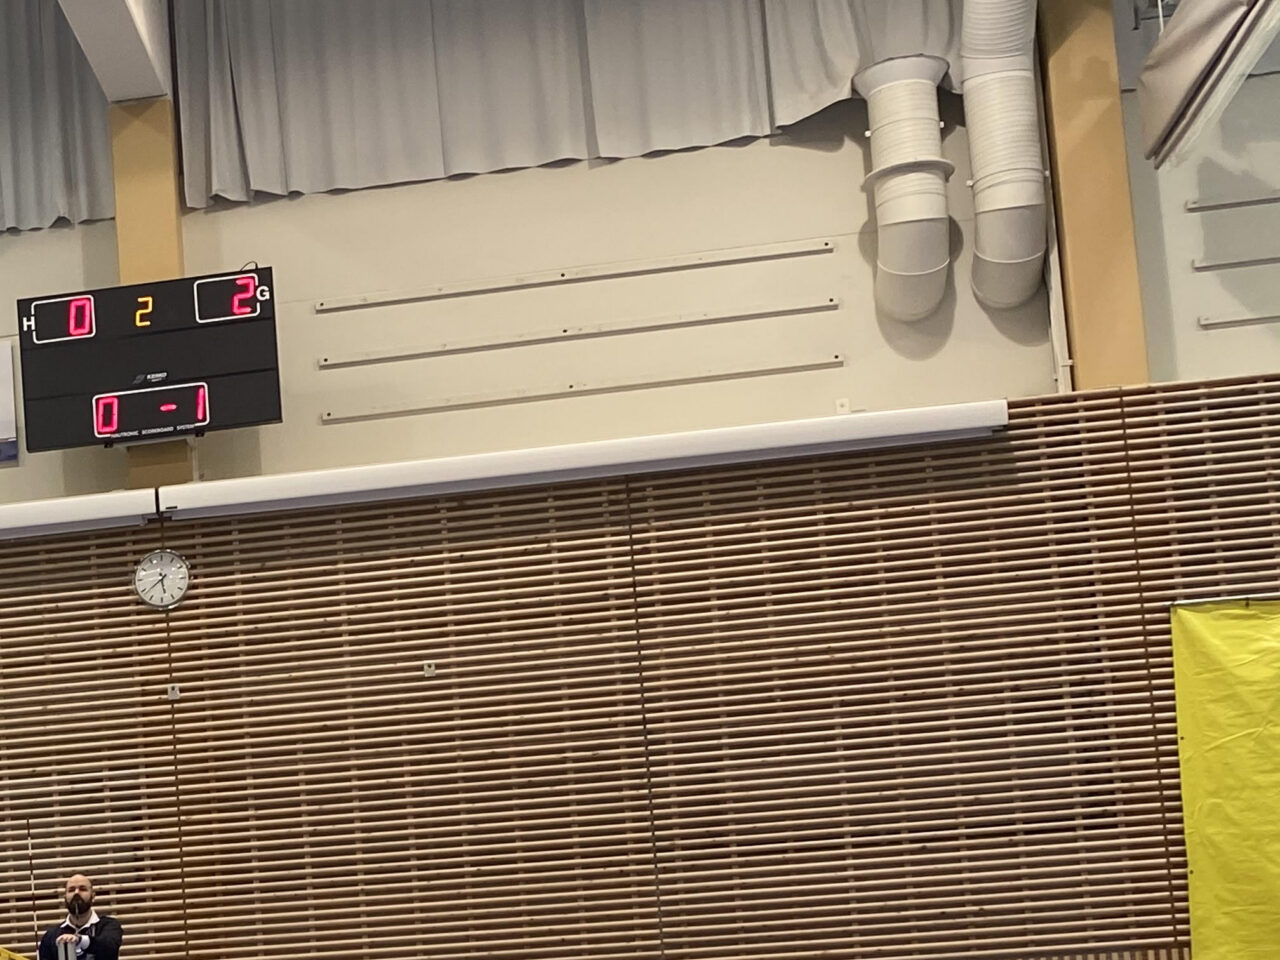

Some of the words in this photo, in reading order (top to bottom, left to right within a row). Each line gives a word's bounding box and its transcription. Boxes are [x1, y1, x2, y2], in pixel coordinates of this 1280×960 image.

[231, 277, 255, 314] 2
[256, 286, 270, 300] G
[22, 316, 35, 331] H
[70, 298, 91, 335] 0
[136, 297, 153, 326] 2
[98, 396, 118, 433] 0
[197, 386, 205, 420] 1
